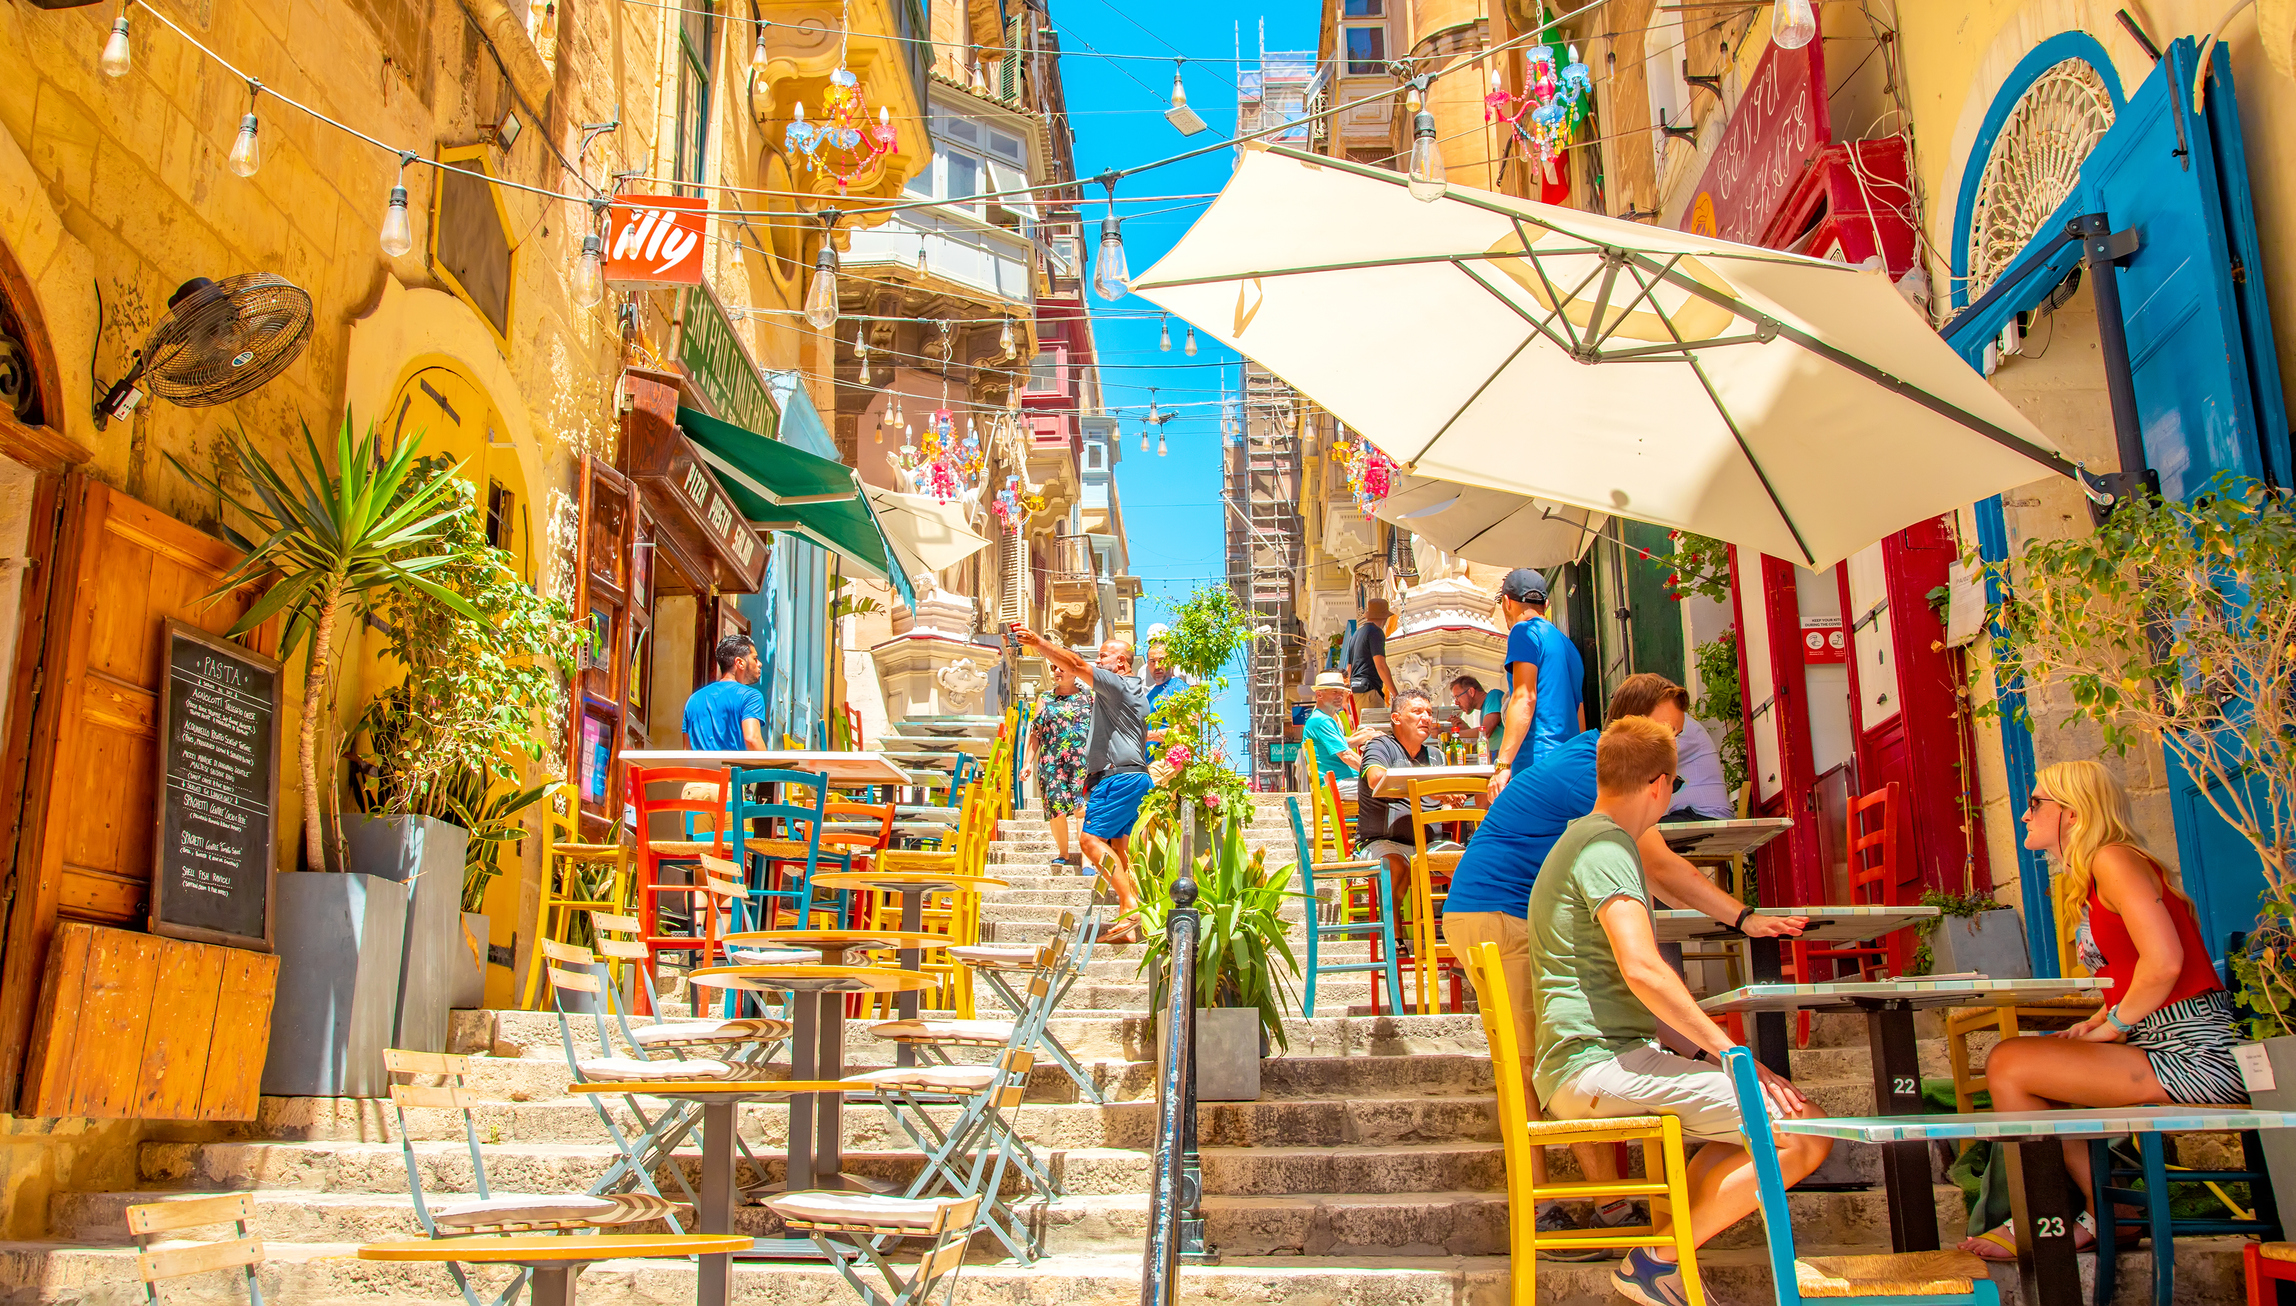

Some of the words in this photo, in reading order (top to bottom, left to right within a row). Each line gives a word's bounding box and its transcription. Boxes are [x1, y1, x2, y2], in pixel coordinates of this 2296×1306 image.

[612, 209, 698, 275] illy
[687, 286, 711, 355] SAN
[707, 313, 738, 401] PAOLO
[701, 365, 719, 406] WINE
[683, 461, 709, 509] PIZZA
[707, 492, 733, 540] PASTA
[731, 523, 755, 567] SALAD
[204, 656, 241, 685] PASTA
[182, 865, 195, 877] SHELL
[198, 870, 210, 880] FISH
[212, 873, 231, 884] RAVIOLI
[1893, 1078, 1916, 1095] 22
[2037, 1216, 2066, 1238] 23
